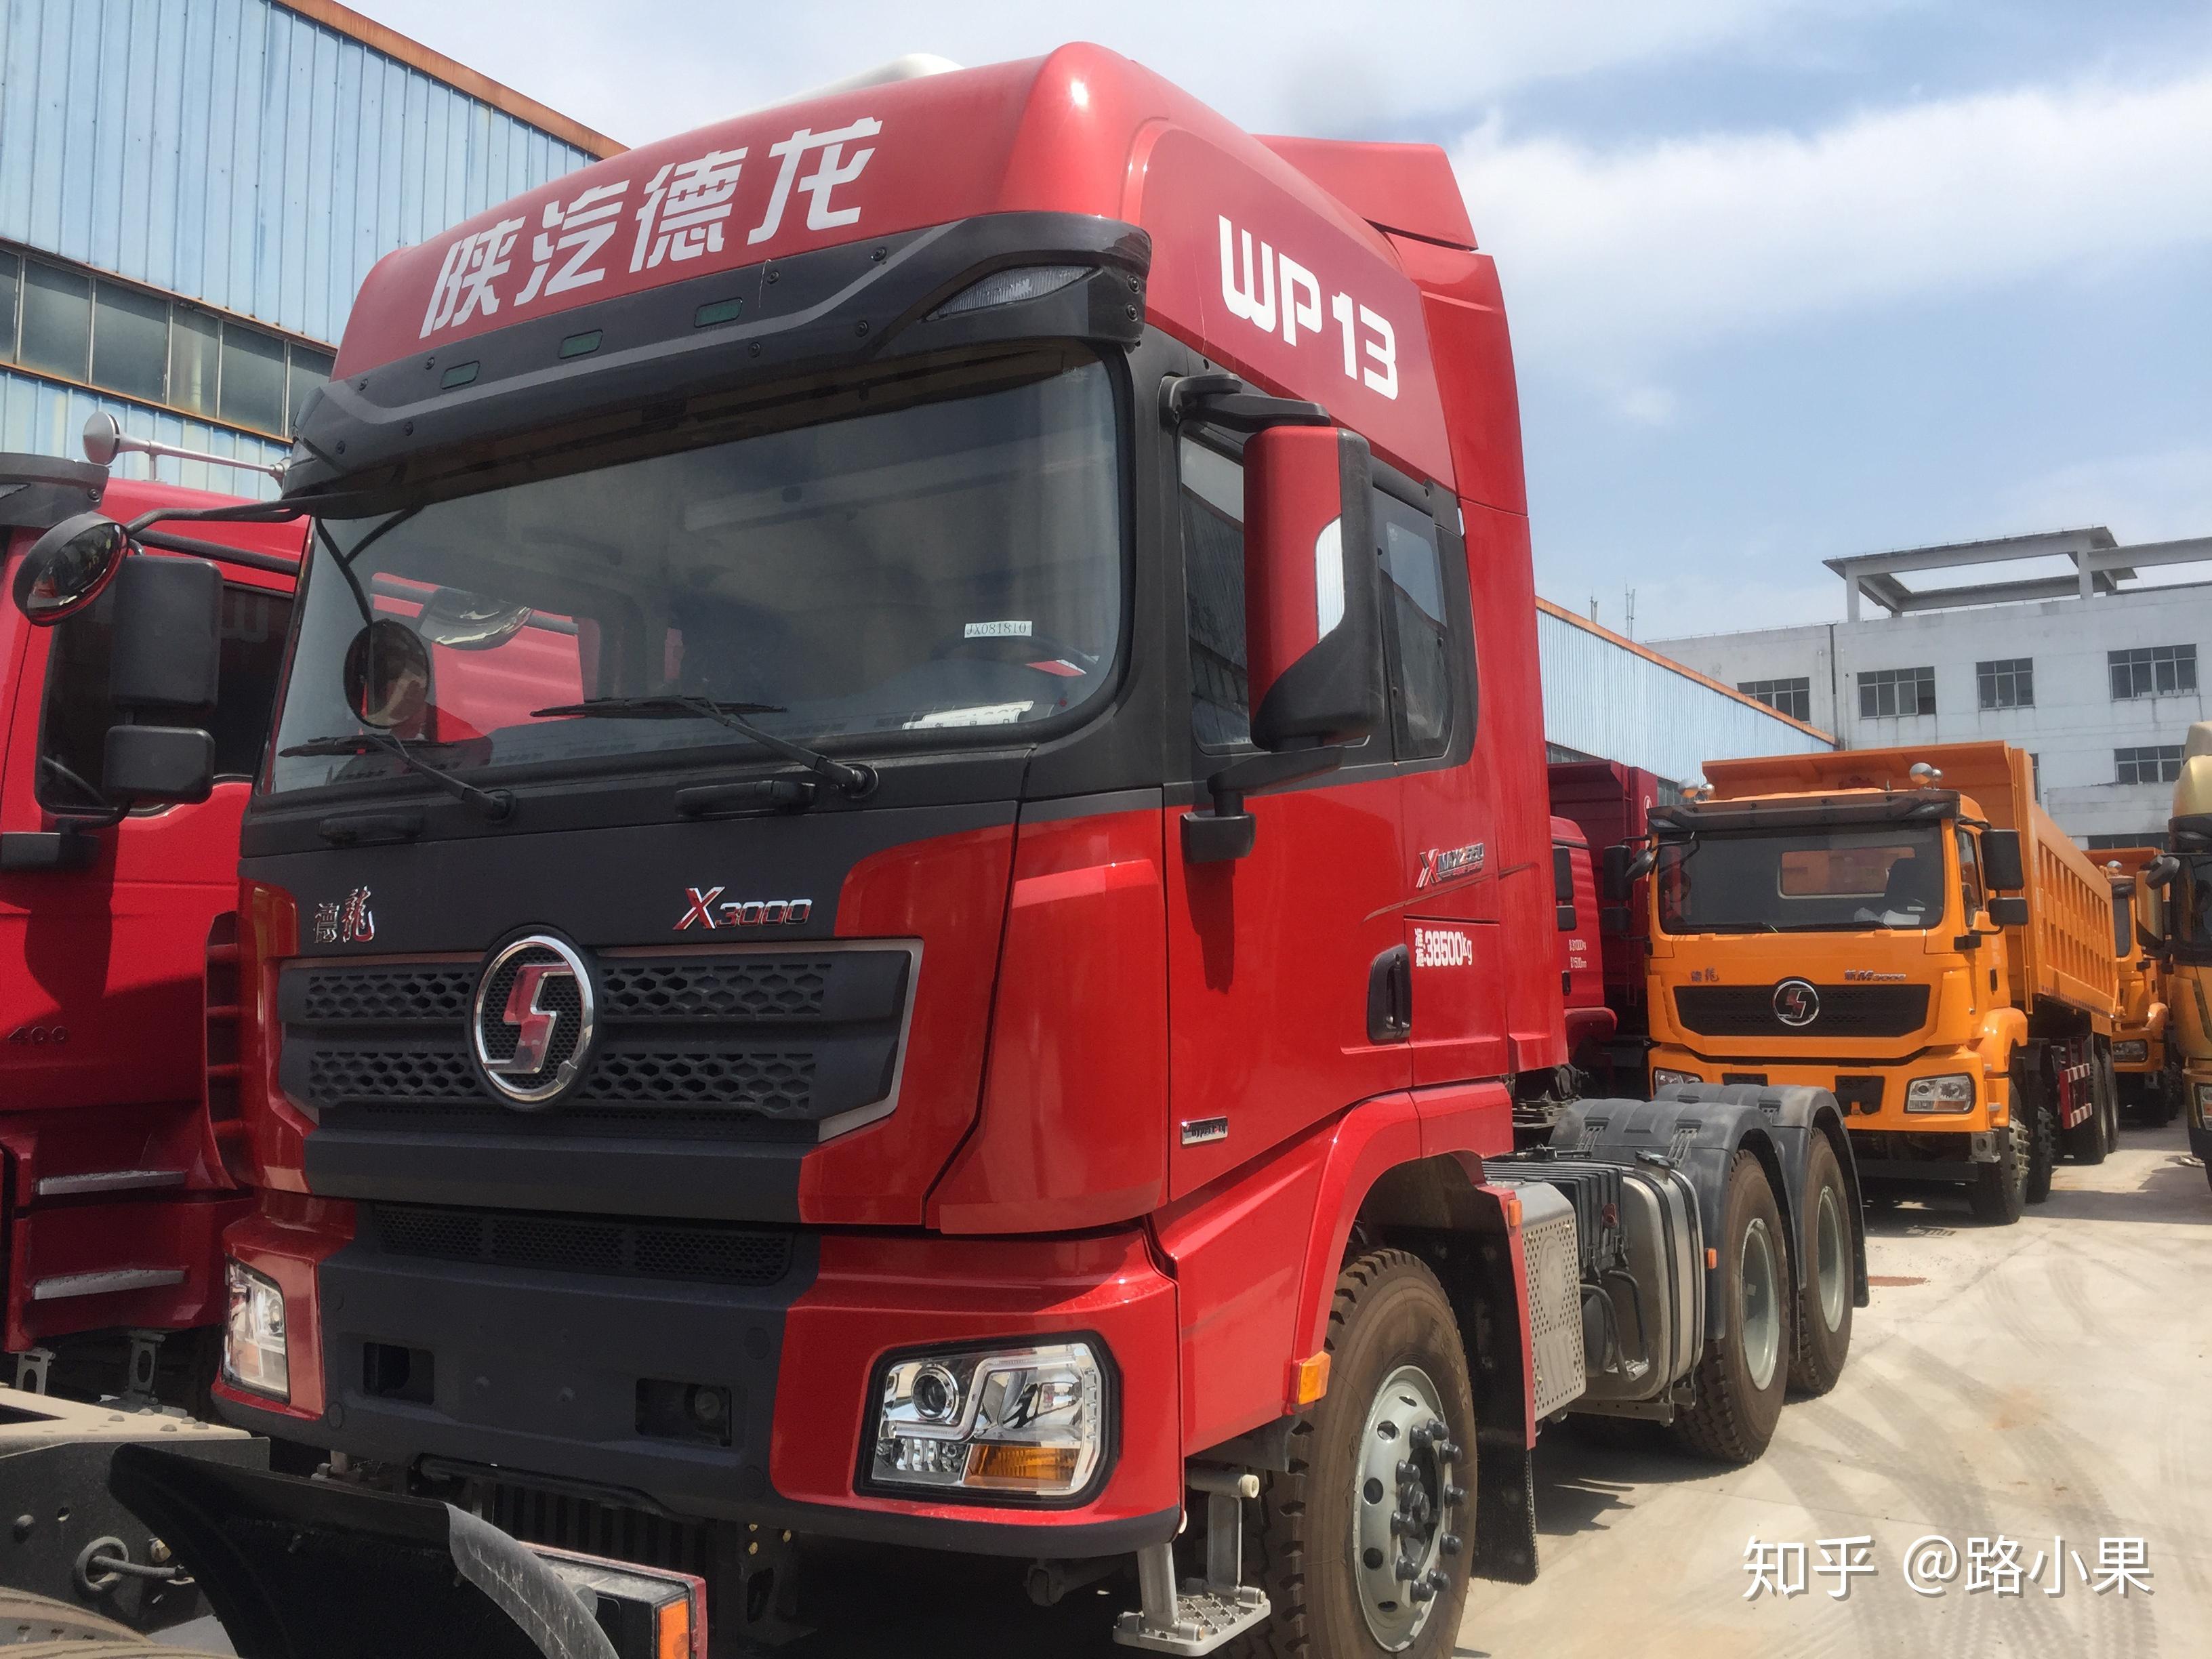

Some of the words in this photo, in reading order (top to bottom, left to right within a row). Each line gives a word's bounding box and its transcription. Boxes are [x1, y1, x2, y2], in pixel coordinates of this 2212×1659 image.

[419, 117, 882, 339] 陕汽德龙
[966, 622, 1027, 635] JX081810
[672, 886, 813, 930] X3000
